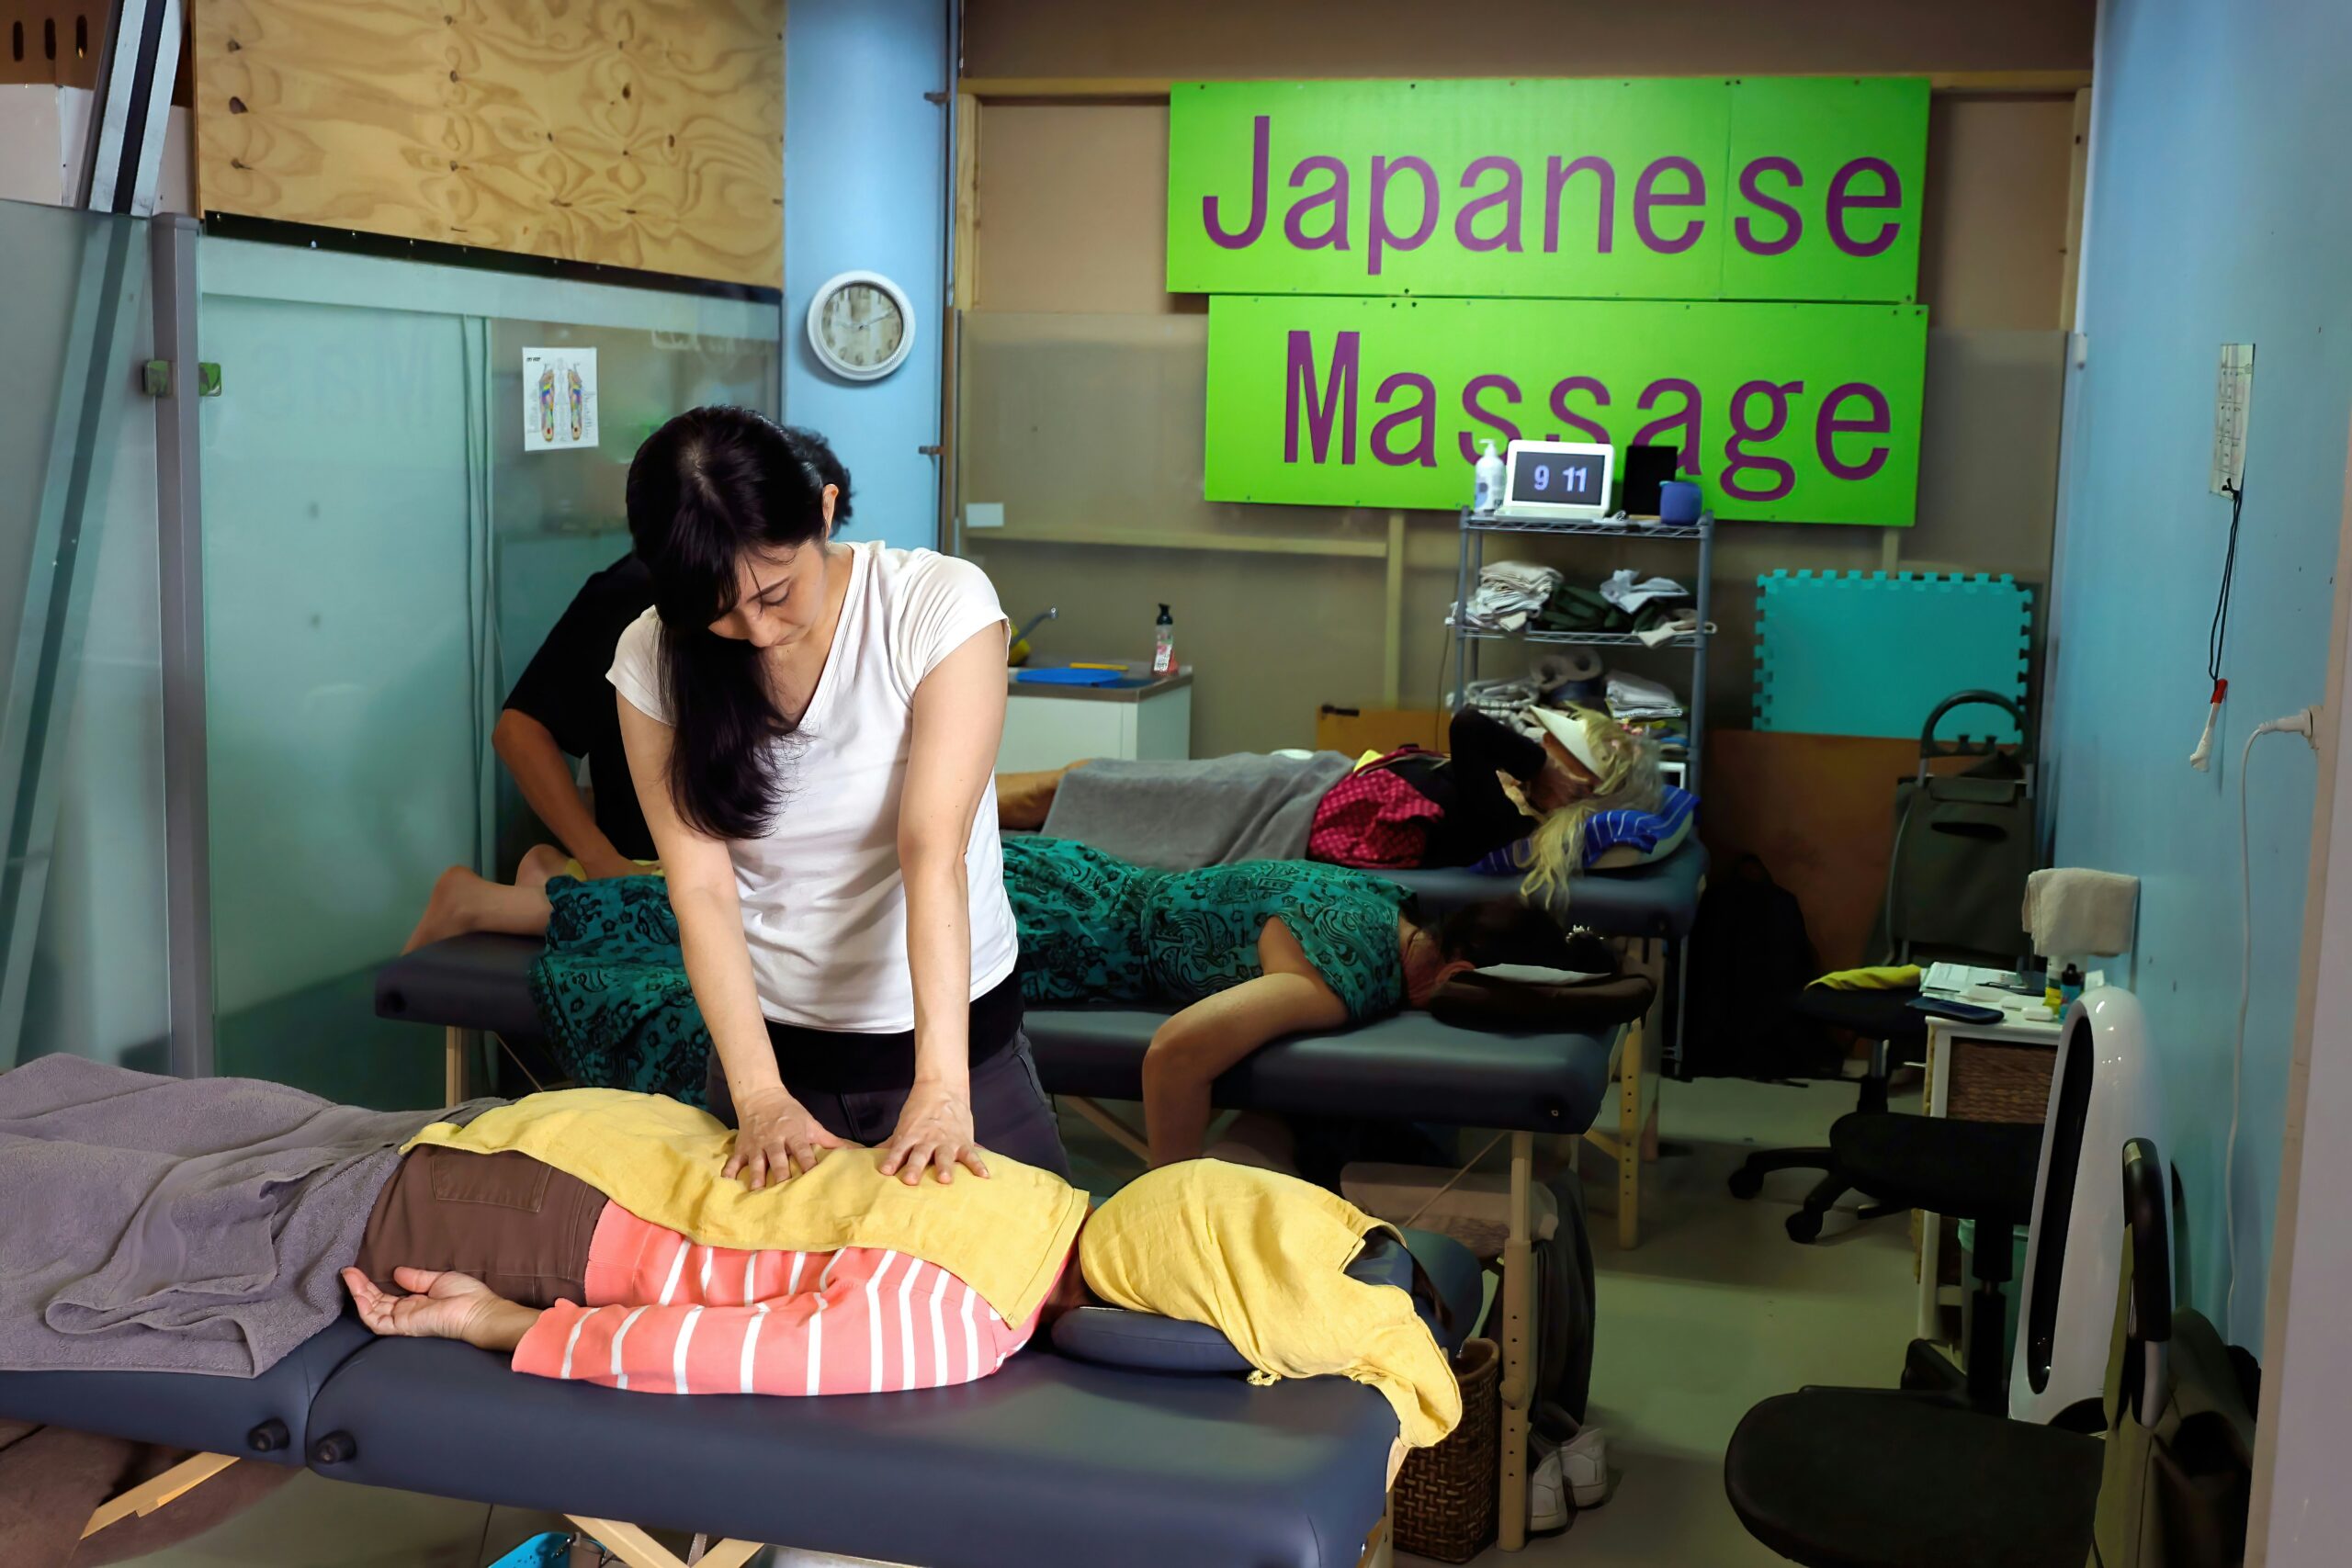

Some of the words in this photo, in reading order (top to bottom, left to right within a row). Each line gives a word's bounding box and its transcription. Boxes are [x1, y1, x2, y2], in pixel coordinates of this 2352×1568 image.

[1203, 115, 1903, 276] Japanese
[1284, 330, 1892, 502] Massage
[1533, 465, 1550, 491] 9
[1563, 466, 1588, 492] 11
